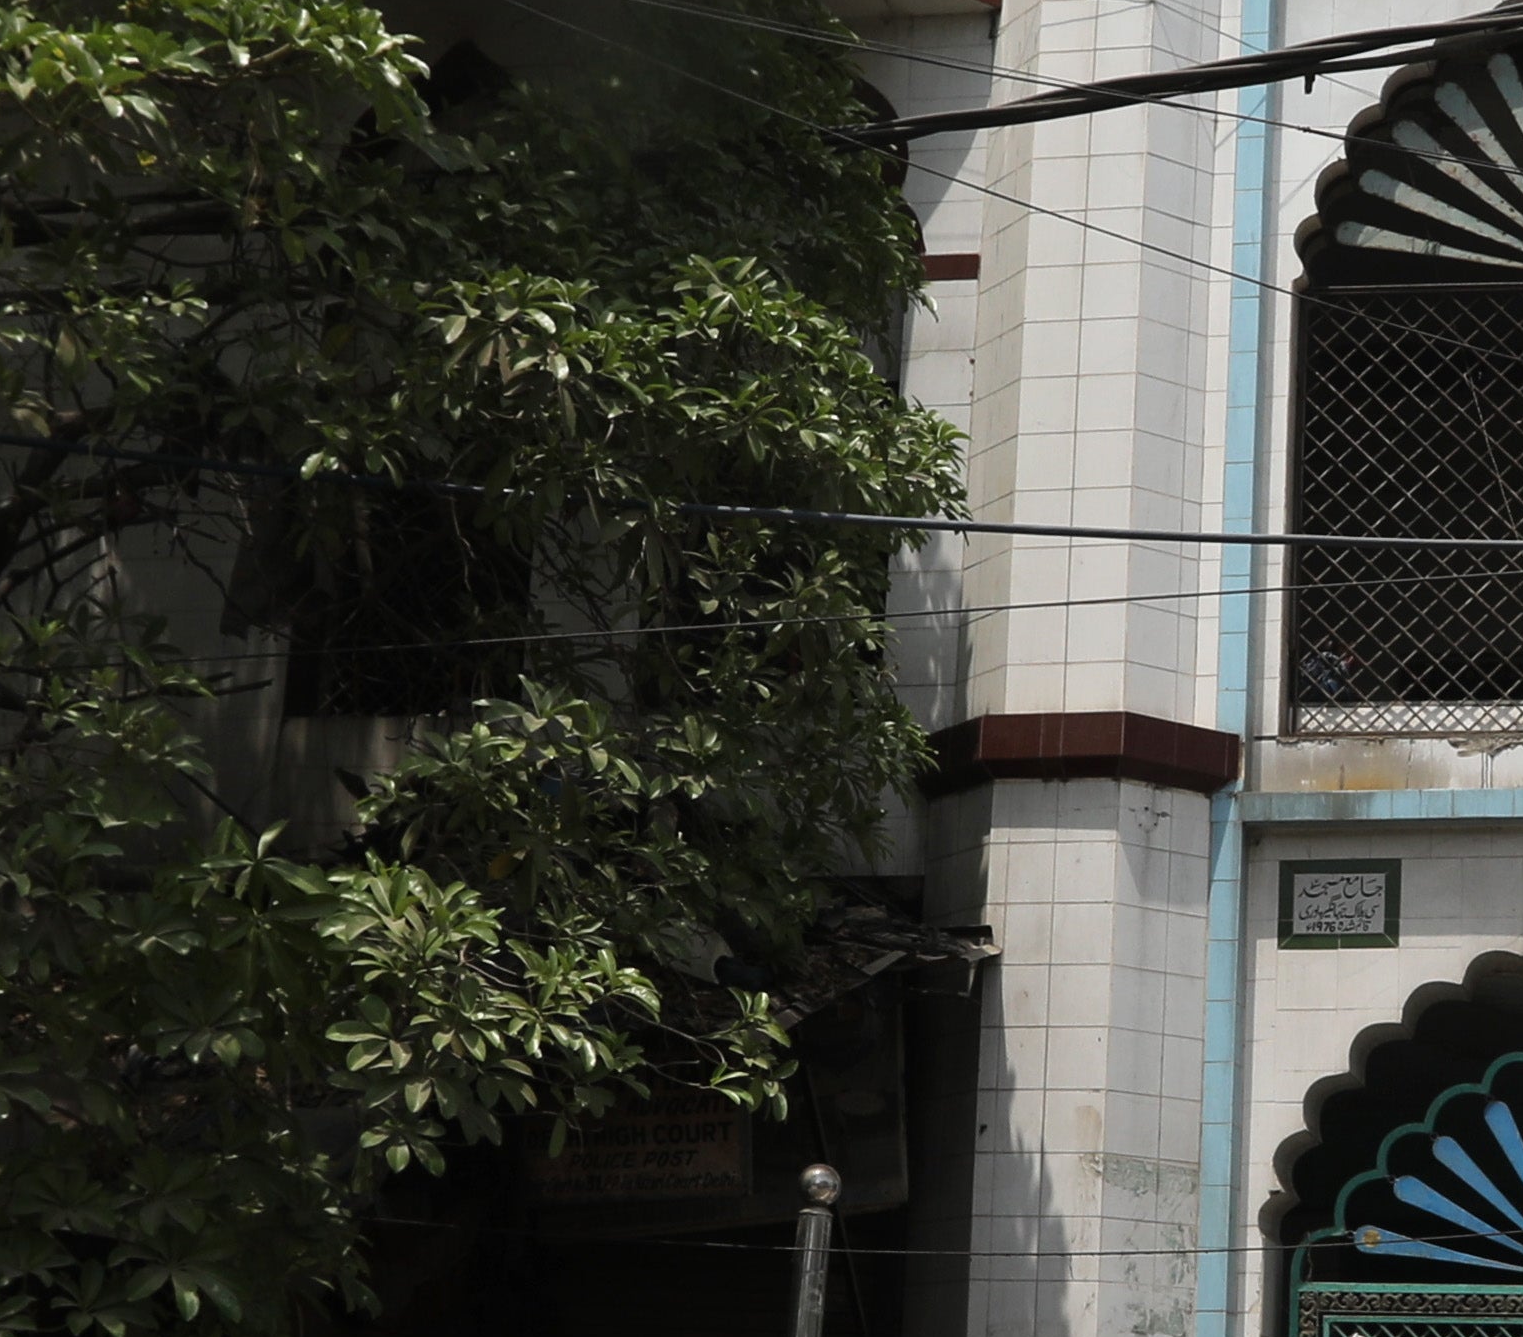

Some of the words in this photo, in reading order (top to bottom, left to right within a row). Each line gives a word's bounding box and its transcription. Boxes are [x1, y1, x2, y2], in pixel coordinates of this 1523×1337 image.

[593, 1123, 646, 1146] HIGH
[652, 1121, 734, 1144] COURT
[572, 1151, 637, 1170] POLICE
[643, 1149, 699, 1167] POST
